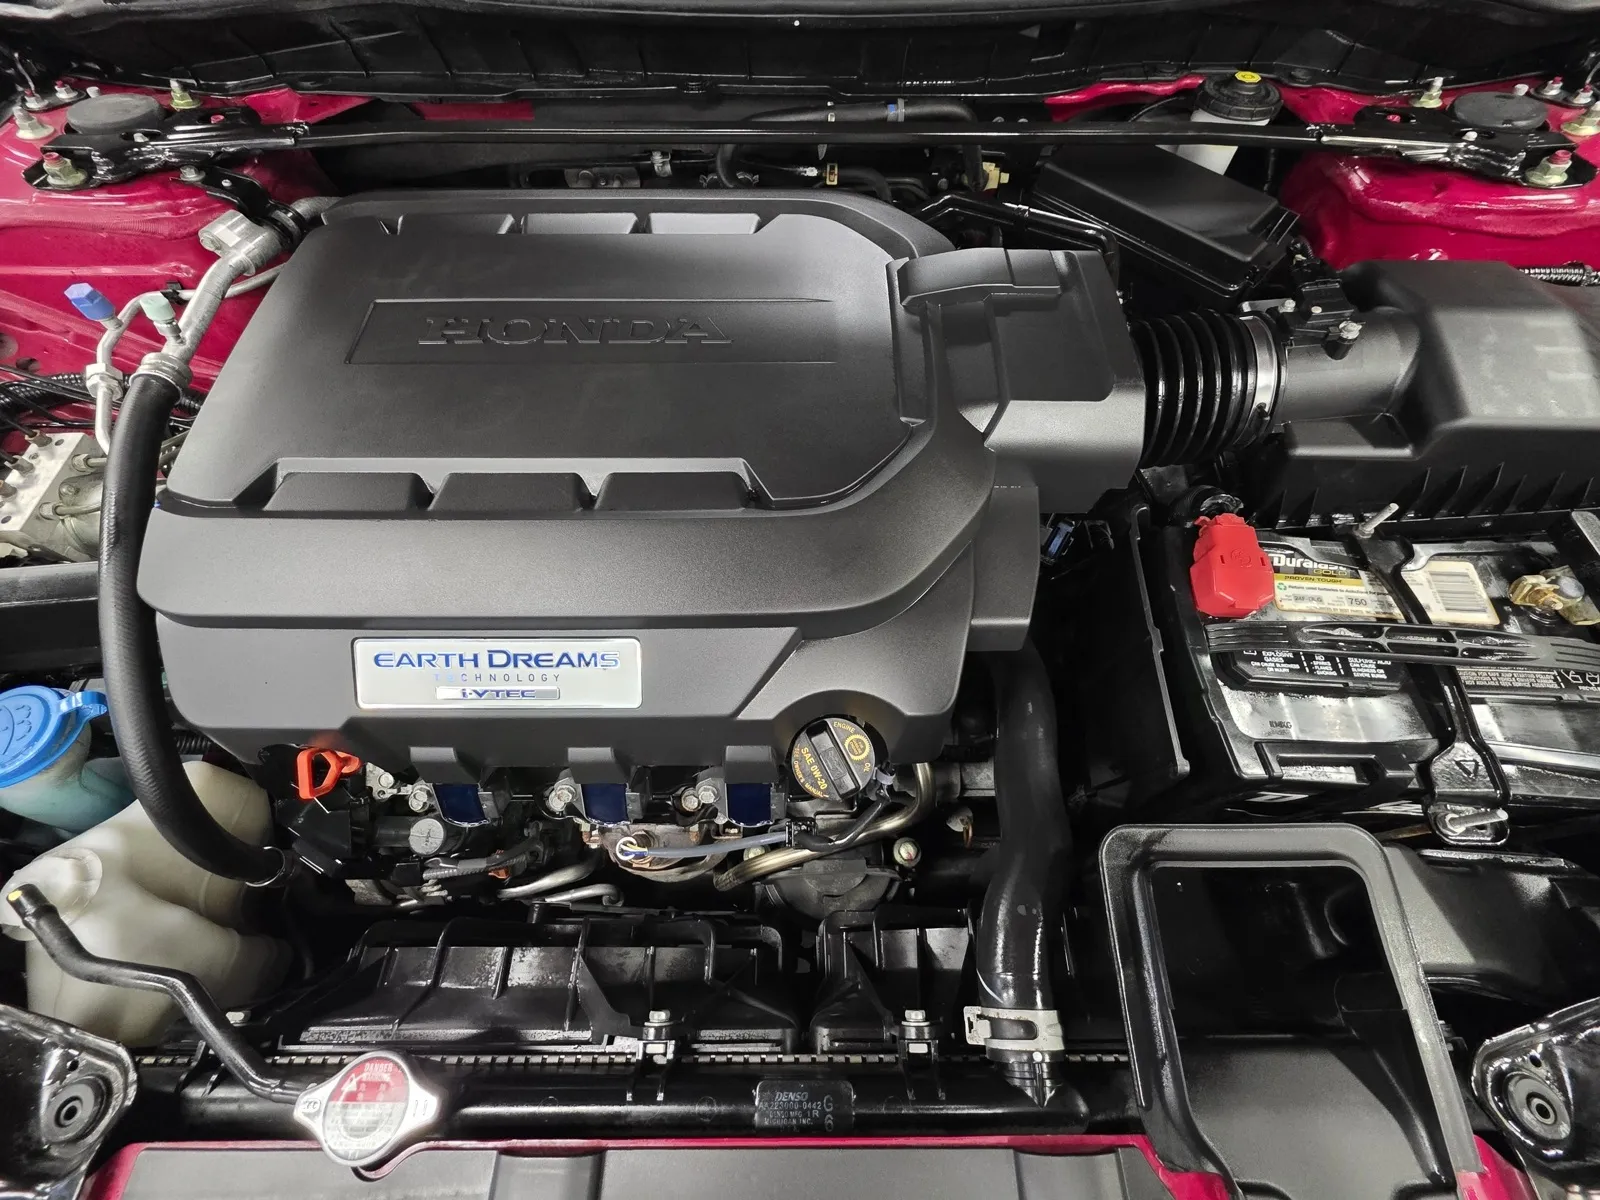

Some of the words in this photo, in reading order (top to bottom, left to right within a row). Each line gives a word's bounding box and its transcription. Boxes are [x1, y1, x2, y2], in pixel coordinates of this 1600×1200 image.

[417, 317, 734, 345] HONDA
[1313, 568, 1347, 576] GOLD
[1347, 597, 1367, 606] 750
[373, 651, 480, 669] EARTH
[486, 650, 620, 669] DREAMS
[434, 673, 560, 682] TECHNOLOGY
[833, 721, 856, 734] ENGINE
[801, 747, 815, 766] SAE
[810, 765, 828, 790] 0W-20
[863, 762, 871, 773] OIL
[804, 782, 824, 798] MANUAL
[364, 1063, 393, 1073] DANGER
[774, 1092, 809, 1101] DENSO
[823, 1095, 834, 1112] G
[764, 1117, 796, 1125] MICHIGAN
[799, 1117, 813, 1125] INC.
[824, 1113, 834, 1132] 6
